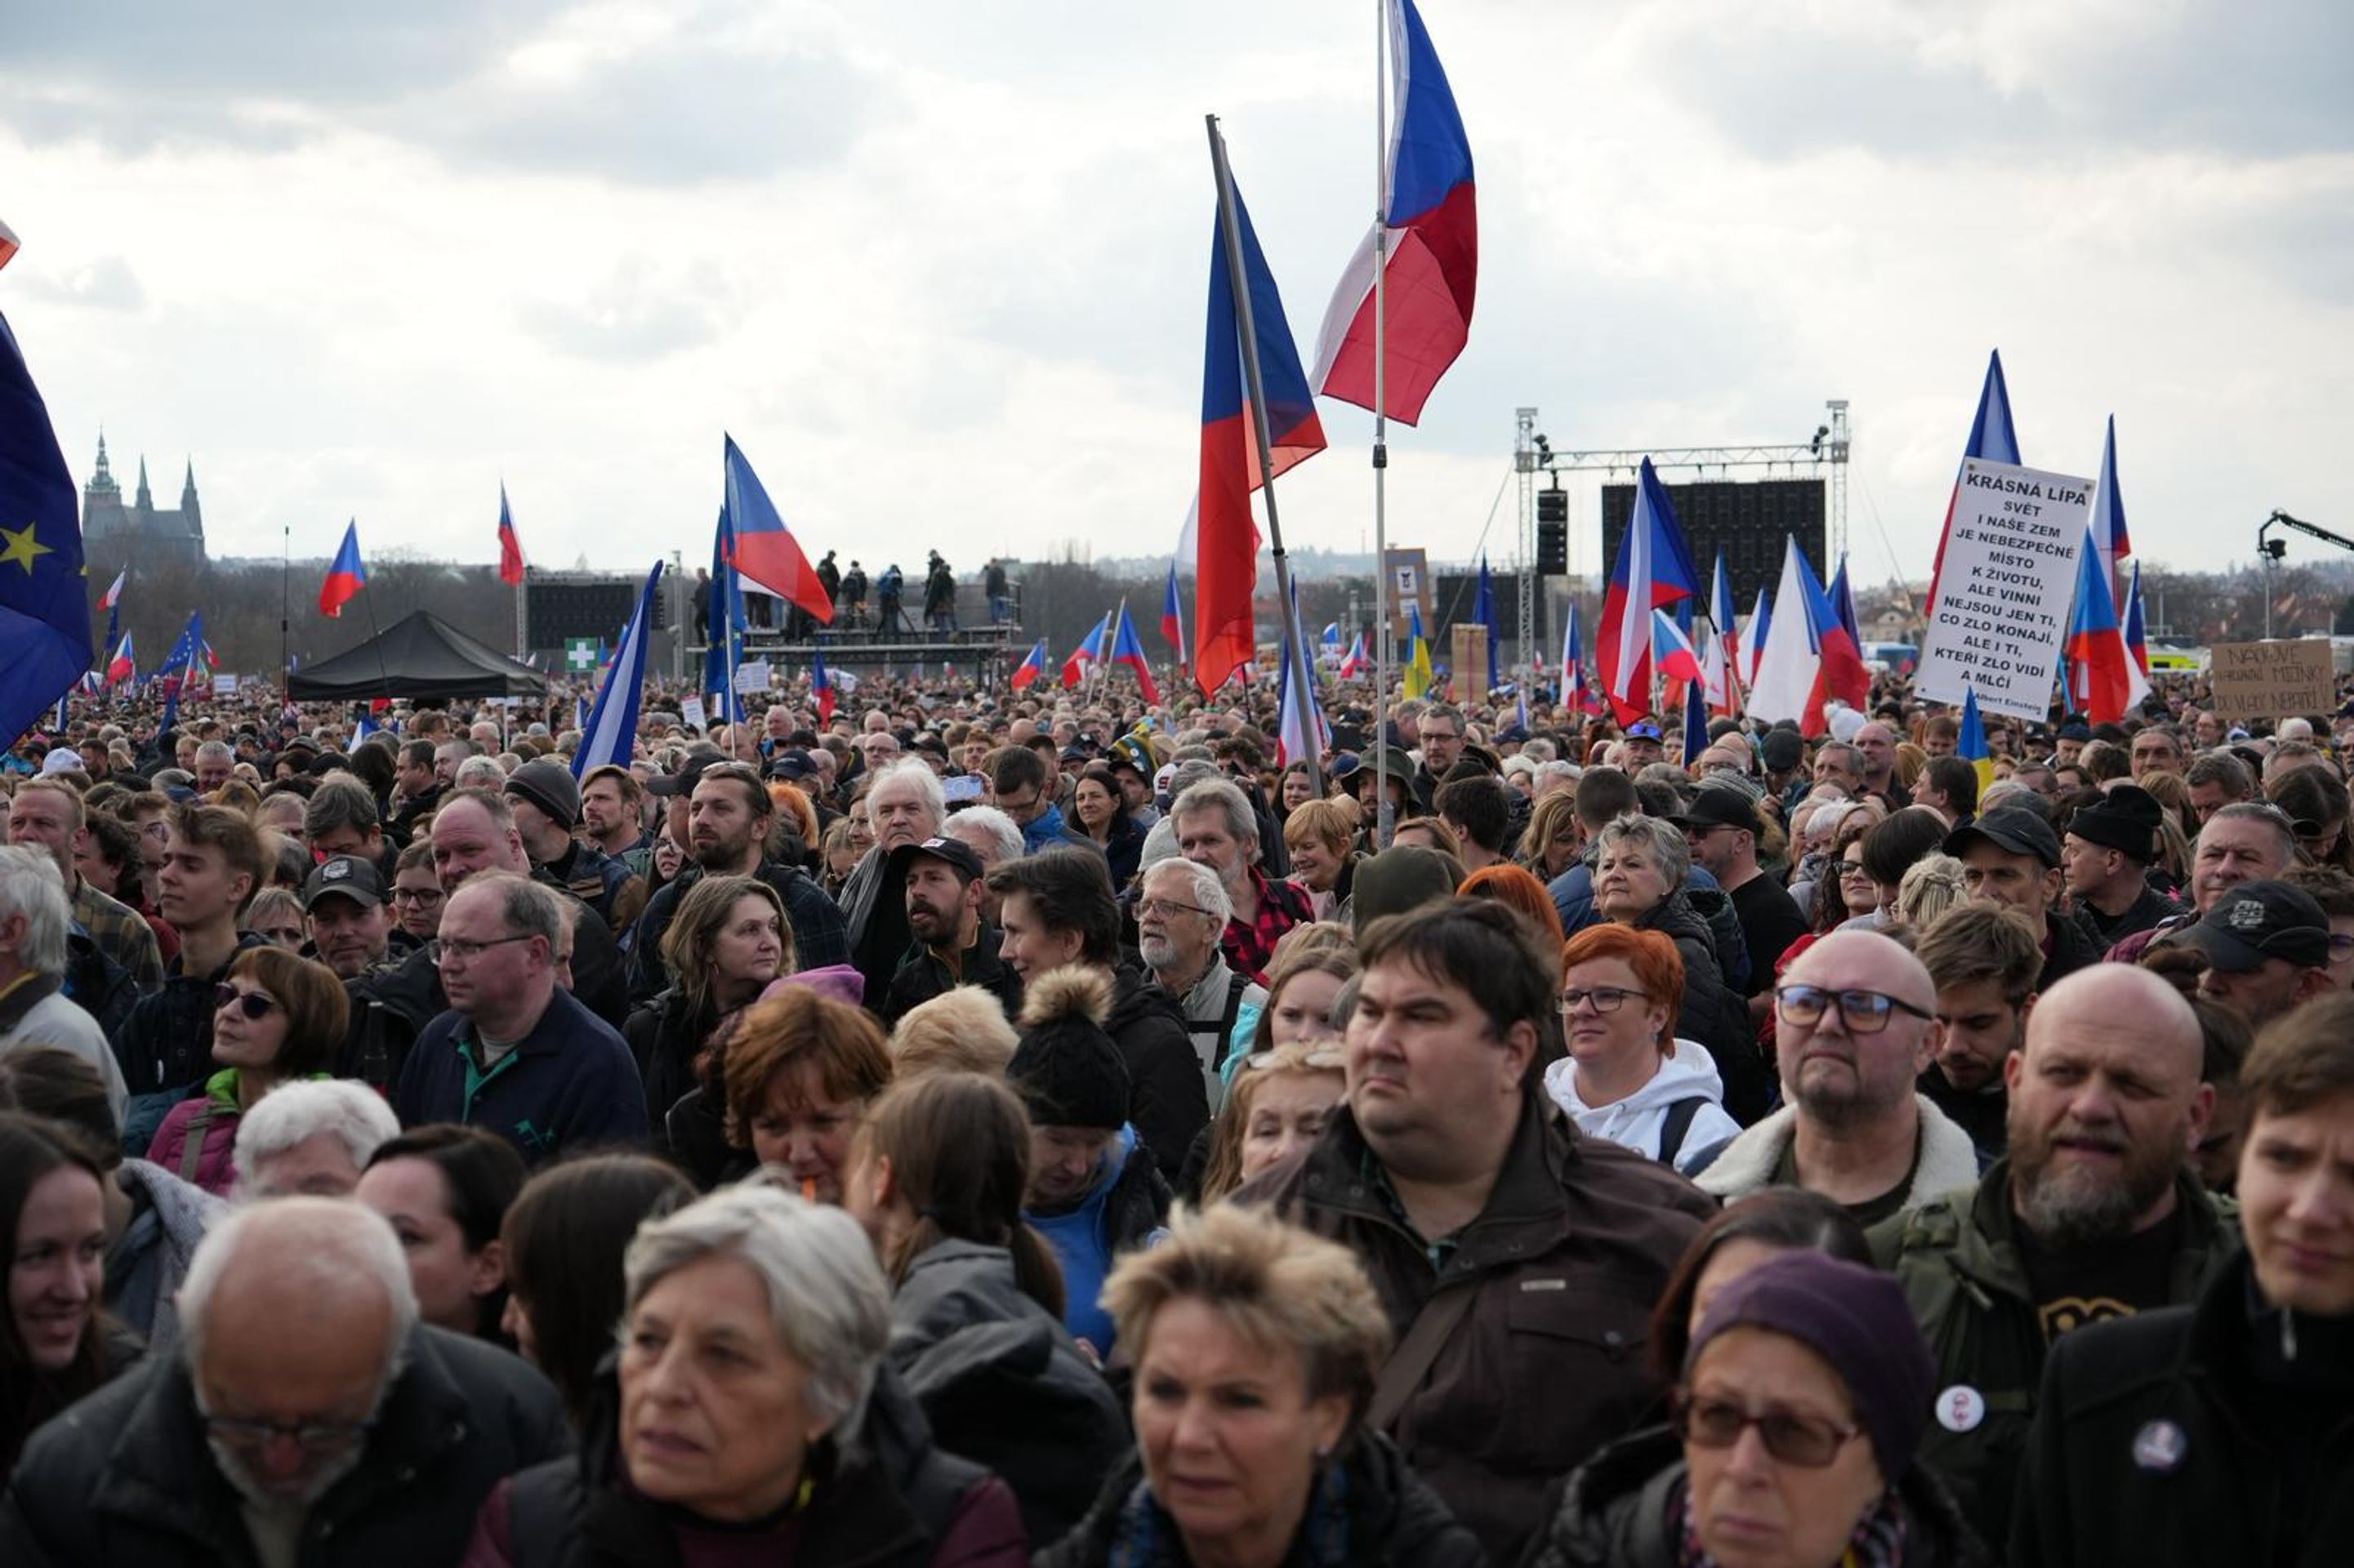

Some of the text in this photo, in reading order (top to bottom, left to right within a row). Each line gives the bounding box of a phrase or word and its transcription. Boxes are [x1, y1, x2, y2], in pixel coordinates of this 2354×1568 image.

[1967, 473, 2087, 506] KRÁSNÁ LÍPA
[1977, 514, 2061, 538] I NAŠE ZEM
[1956, 528, 2075, 559] JE NEBEZPEČNÉ
[1972, 566, 1982, 577] K
[1989, 551, 2035, 569] MÍSTO
[1968, 583, 1995, 597] ALE
[1944, 596, 2058, 629] NEJSOU JEN TI,
[1940, 613, 2054, 646] CO ZLO KONAJÍ,
[1964, 635, 2022, 658] ALE I TI,
[1982, 657, 2010, 670] ZLO
[2016, 662, 2045, 678] VIDÍ
[1961, 670, 2011, 689] A MLČÍ
